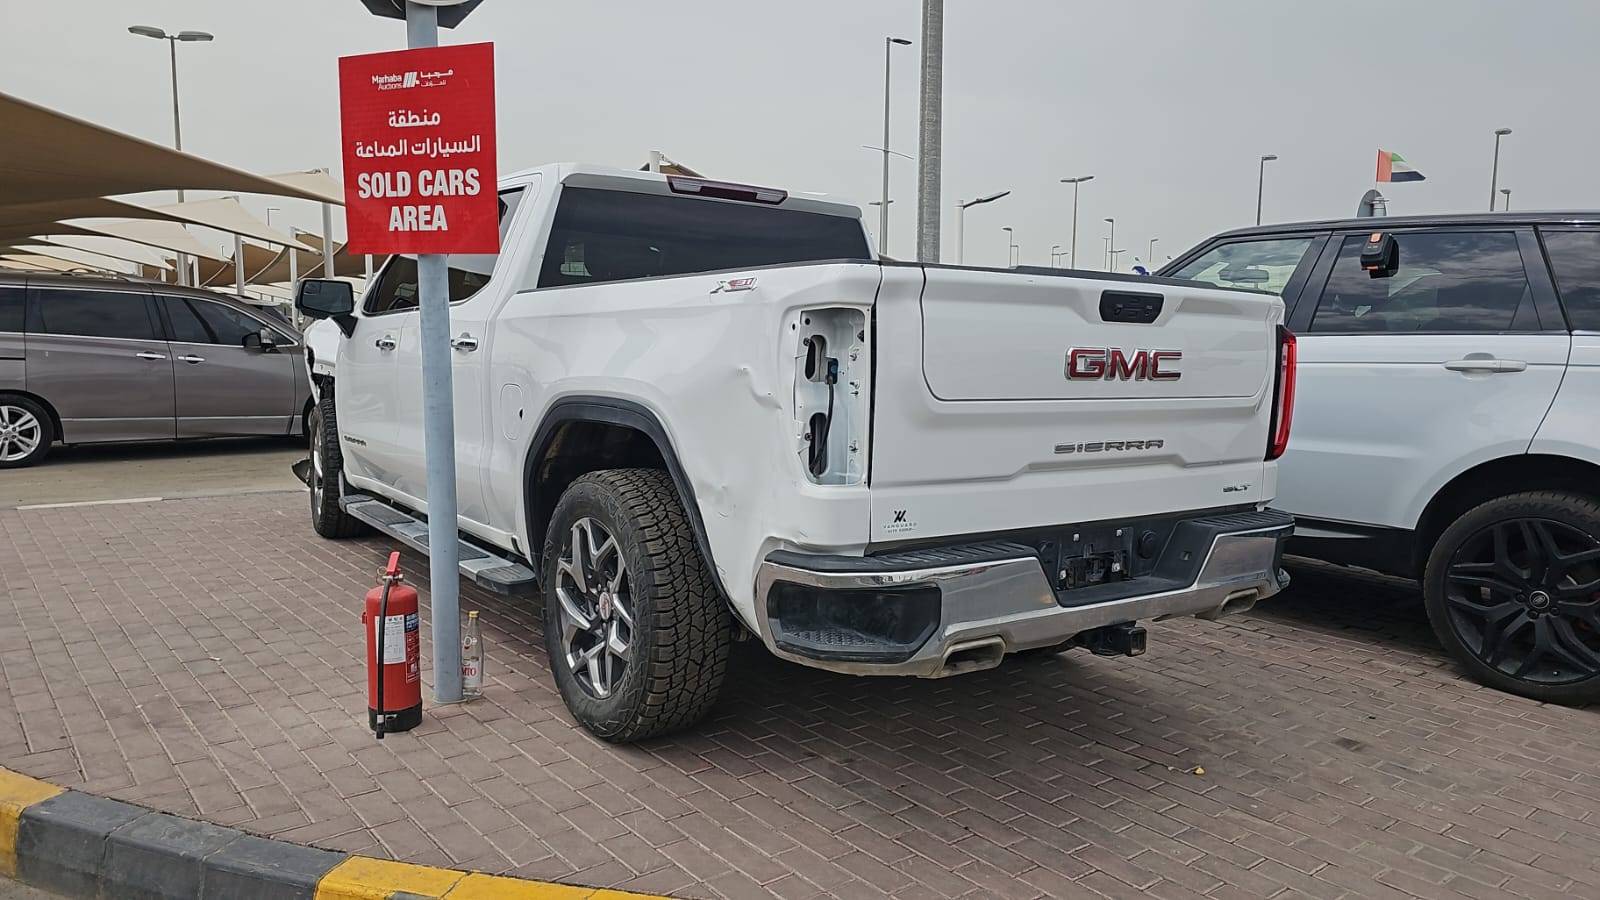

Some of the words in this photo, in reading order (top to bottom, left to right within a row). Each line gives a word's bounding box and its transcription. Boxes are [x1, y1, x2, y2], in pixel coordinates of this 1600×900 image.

[372, 73, 402, 84] Marhaba
[378, 82, 402, 90] Auctions
[389, 109, 440, 127] منطقة
[411, 135, 480, 158] السيارات
[358, 171, 411, 198] SOLD
[418, 168, 480, 197] CARS
[389, 205, 448, 231] AREA
[1064, 347, 1182, 381] GMC
[1054, 440, 1164, 454] SIERRA
